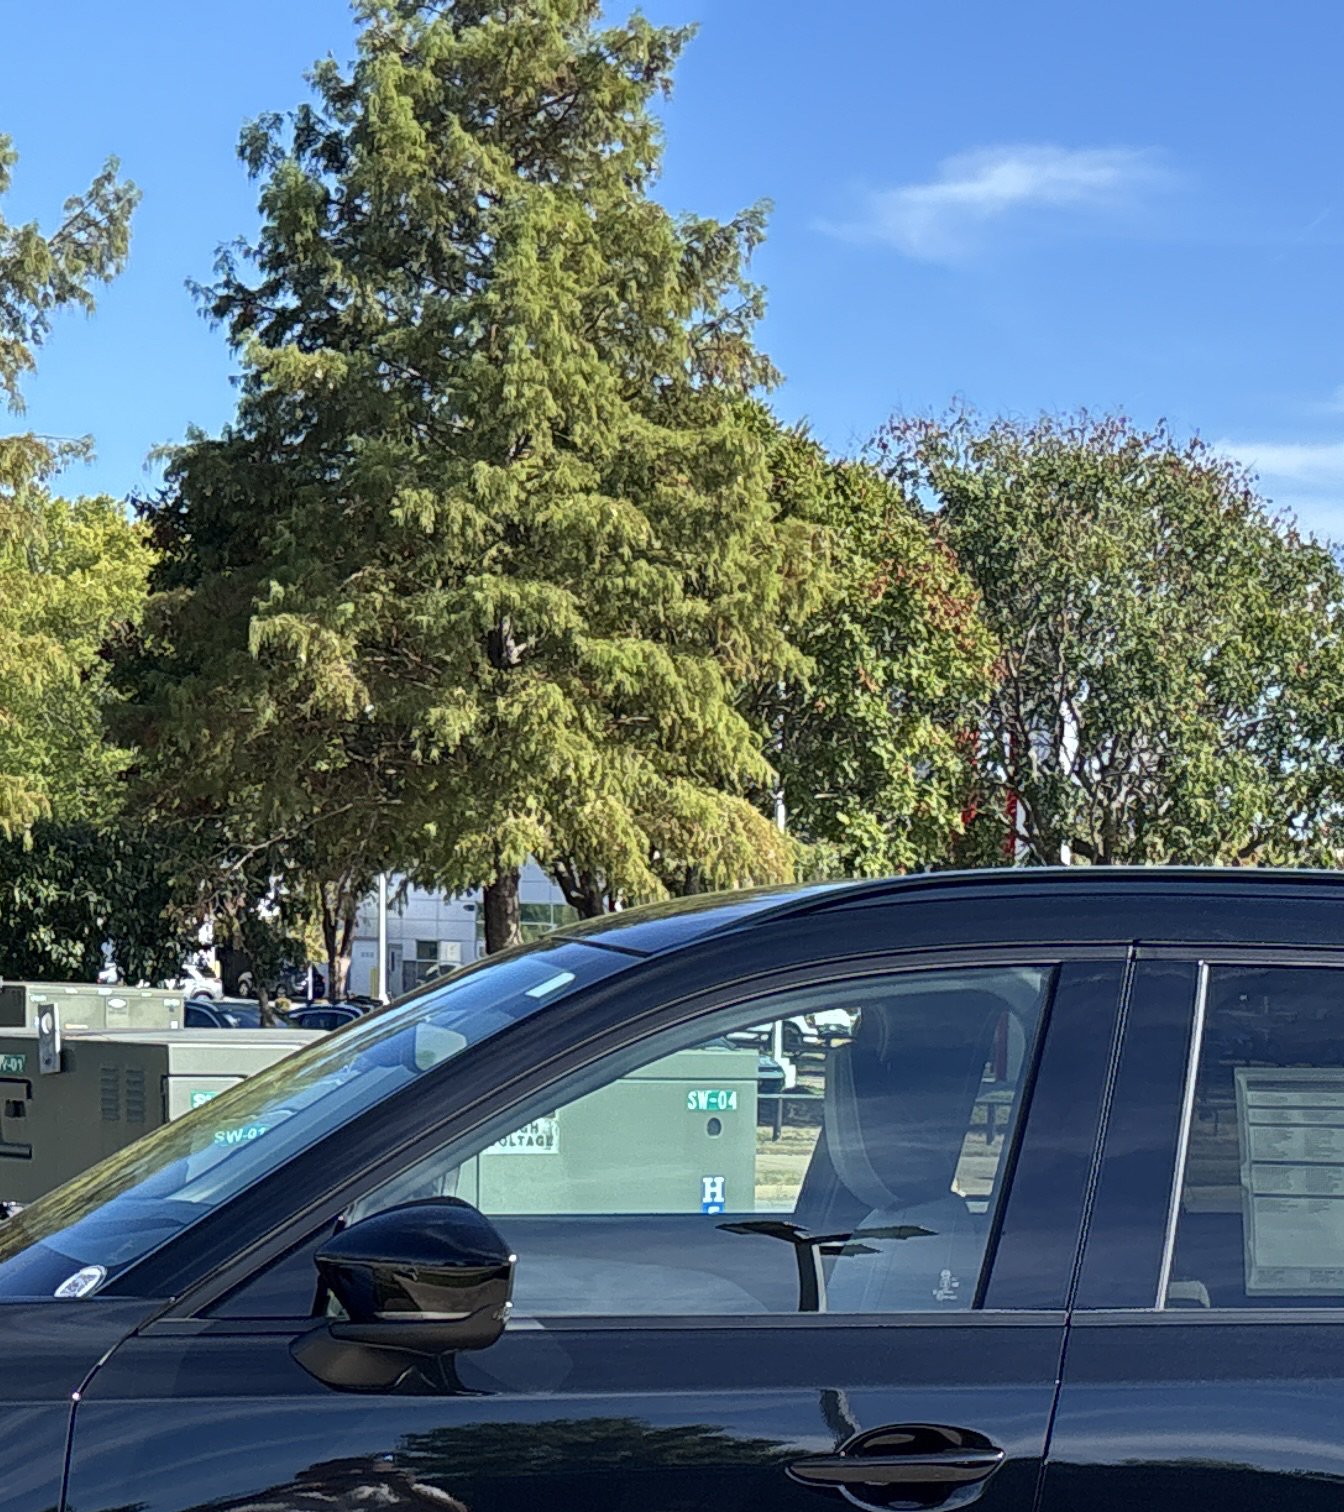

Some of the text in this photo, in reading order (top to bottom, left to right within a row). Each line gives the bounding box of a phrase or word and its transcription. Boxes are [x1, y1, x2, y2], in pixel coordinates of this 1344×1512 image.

[687, 1089, 737, 1110] SW-04
[214, 1126, 267, 1144] SW-01
[498, 1134, 554, 1147] OLTAGE
[702, 1176, 725, 1203] H
